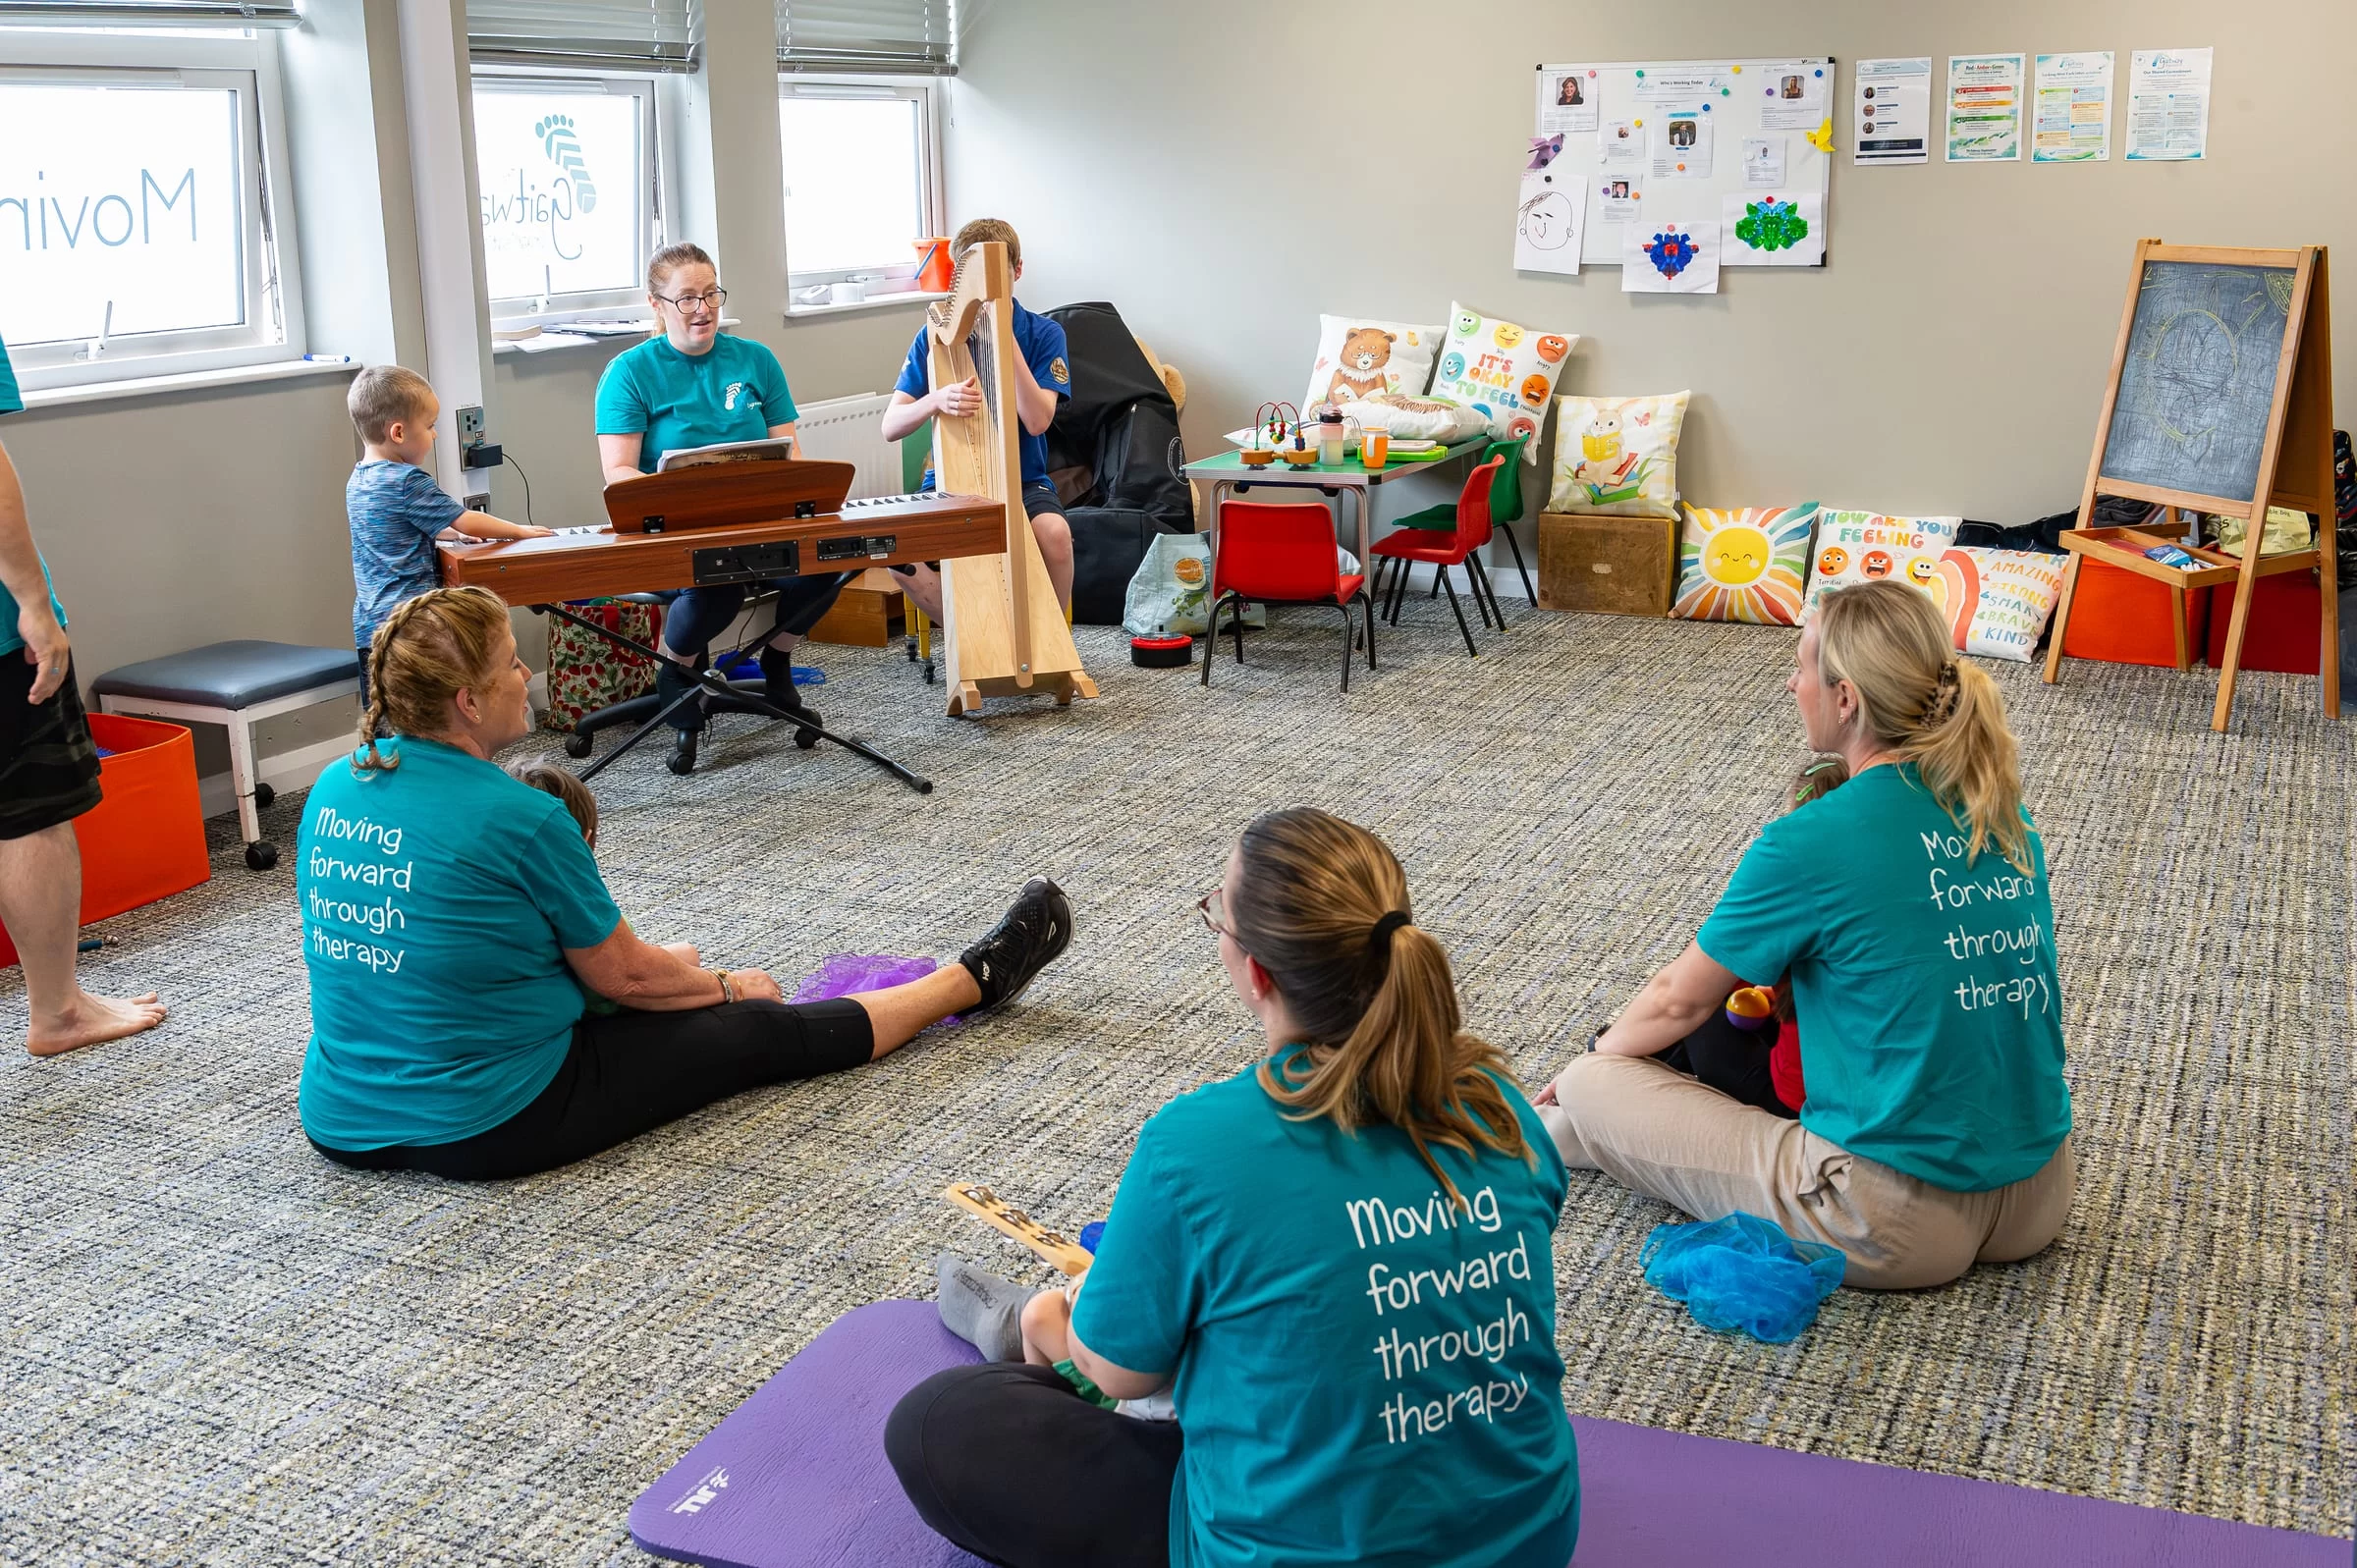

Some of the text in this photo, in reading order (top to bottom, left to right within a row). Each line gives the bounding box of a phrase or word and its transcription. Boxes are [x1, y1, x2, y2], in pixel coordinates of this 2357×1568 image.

[1468, 366, 1514, 389] OKAY
[1478, 353, 1512, 373] IT'S
[1455, 380, 1519, 408] TO FEEL
[1823, 512, 1952, 537] HOW ARE YOU
[1838, 528, 1925, 549] FEELING
[1989, 582, 2050, 609] STRONG
[1990, 561, 2062, 592] AMAZING
[1986, 611, 2038, 638] BRAVE
[1988, 596, 2042, 623] SMART
[1985, 626, 2029, 646] KIND
[314, 806, 403, 854] Moving
[309, 845, 413, 892] forward
[308, 886, 405, 935] through
[312, 925, 406, 974] therapy
[1944, 912, 2046, 965] through
[1953, 972, 2050, 1021] therapy
[1345, 1185, 1503, 1250] Moving
[1366, 1230, 1532, 1316] forward
[1373, 1297, 1530, 1381] through
[1379, 1371, 1529, 1444] therapy
